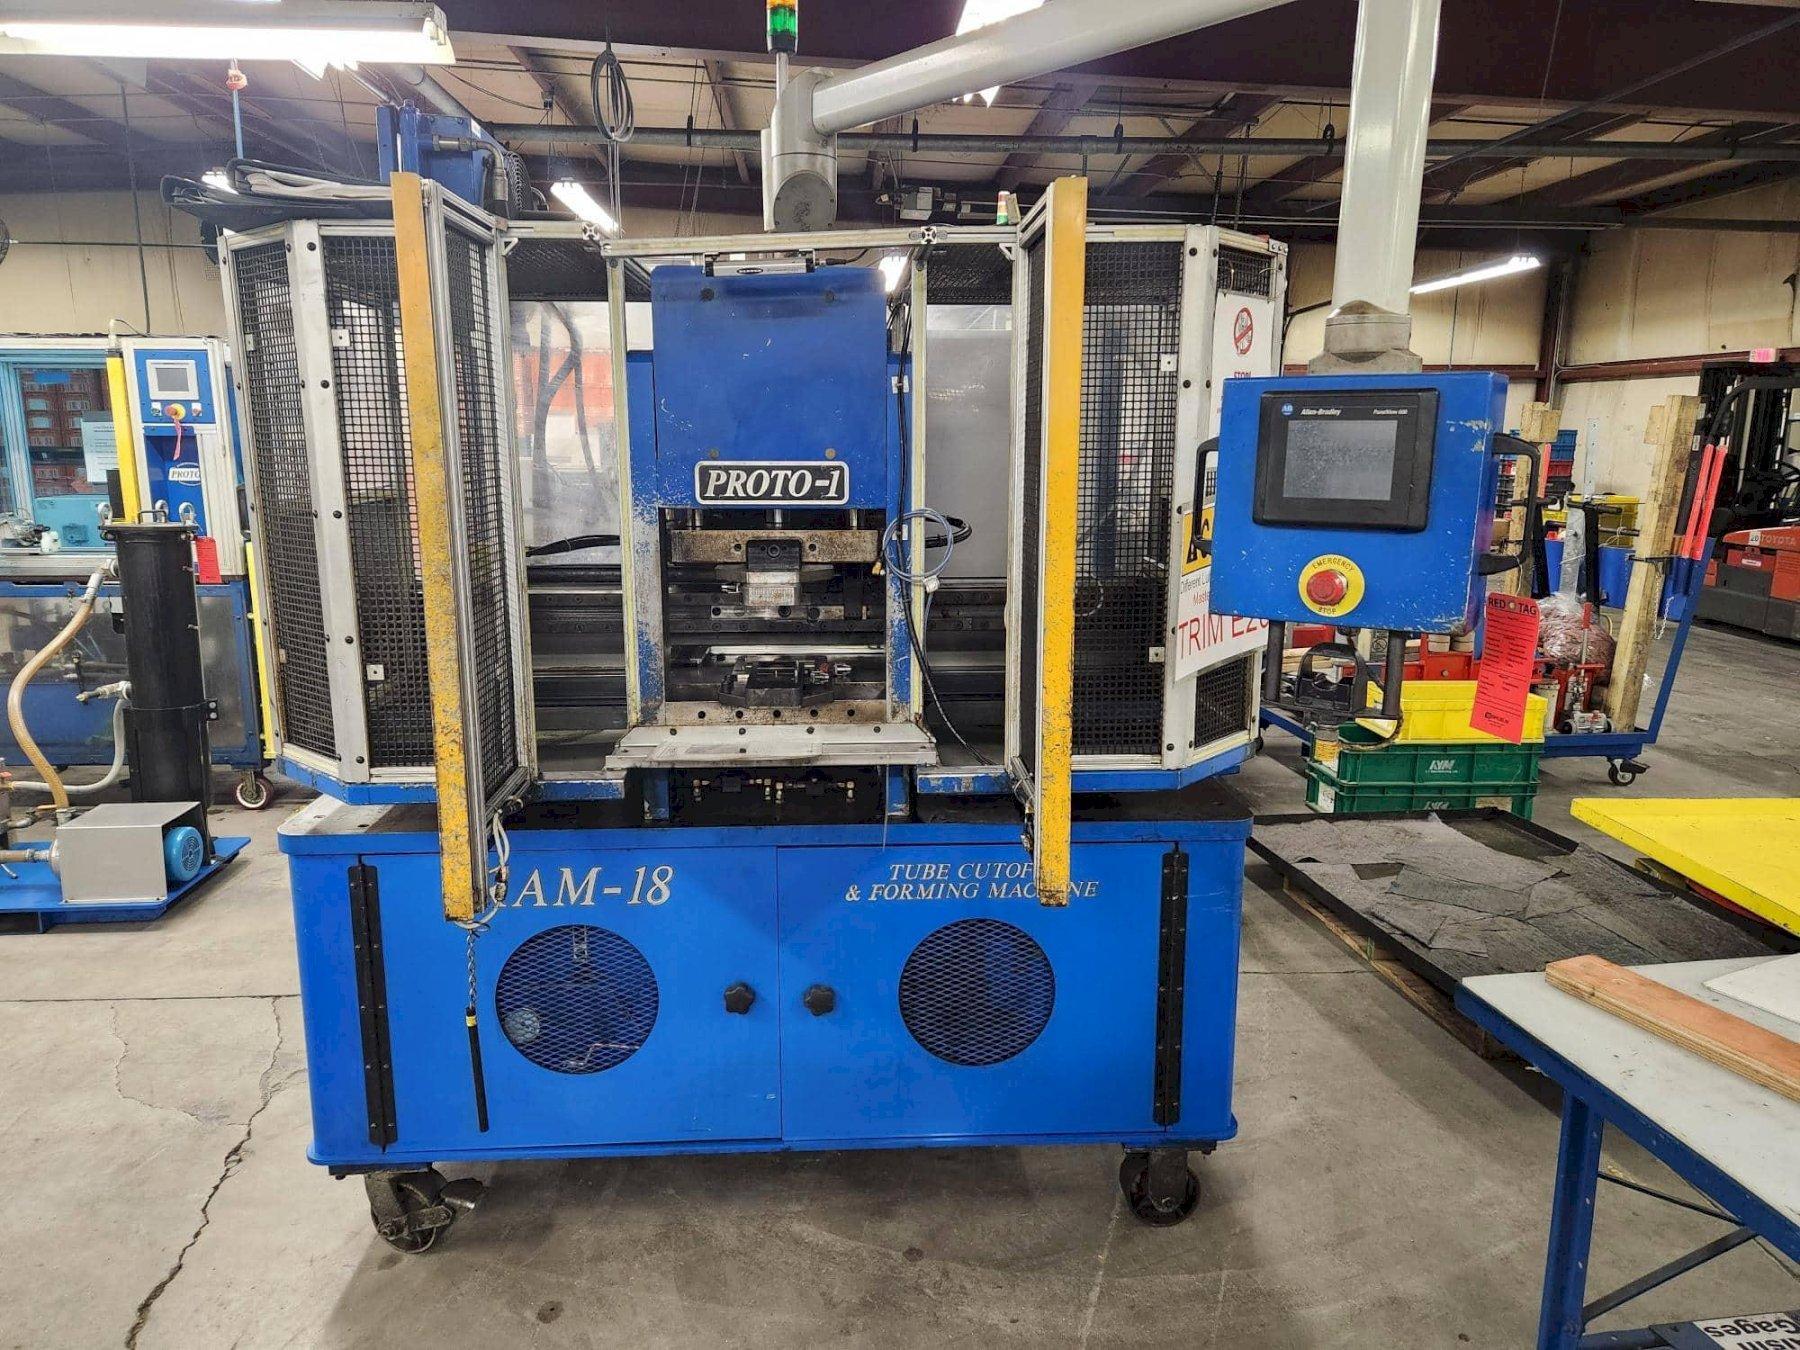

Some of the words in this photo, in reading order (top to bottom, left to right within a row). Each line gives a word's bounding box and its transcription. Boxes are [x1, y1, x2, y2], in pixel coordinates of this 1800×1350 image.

[1300, 407, 1342, 416] Allen-Bradley
[703, 468, 841, 498] PROTO-1
[1313, 557, 1356, 572] EMERGENCY
[1318, 606, 1337, 615] STOP
[1488, 597, 1506, 609] RED
[1518, 602, 1537, 615] TAG
[1178, 613, 1223, 659] TRIM
[889, 862, 951, 881] TUBE
[957, 861, 1035, 880] CUTOF
[490, 866, 675, 908] AM-18
[845, 885, 861, 902] &
[867, 881, 980, 902] FORMING
[988, 881, 1100, 899] MACNE
